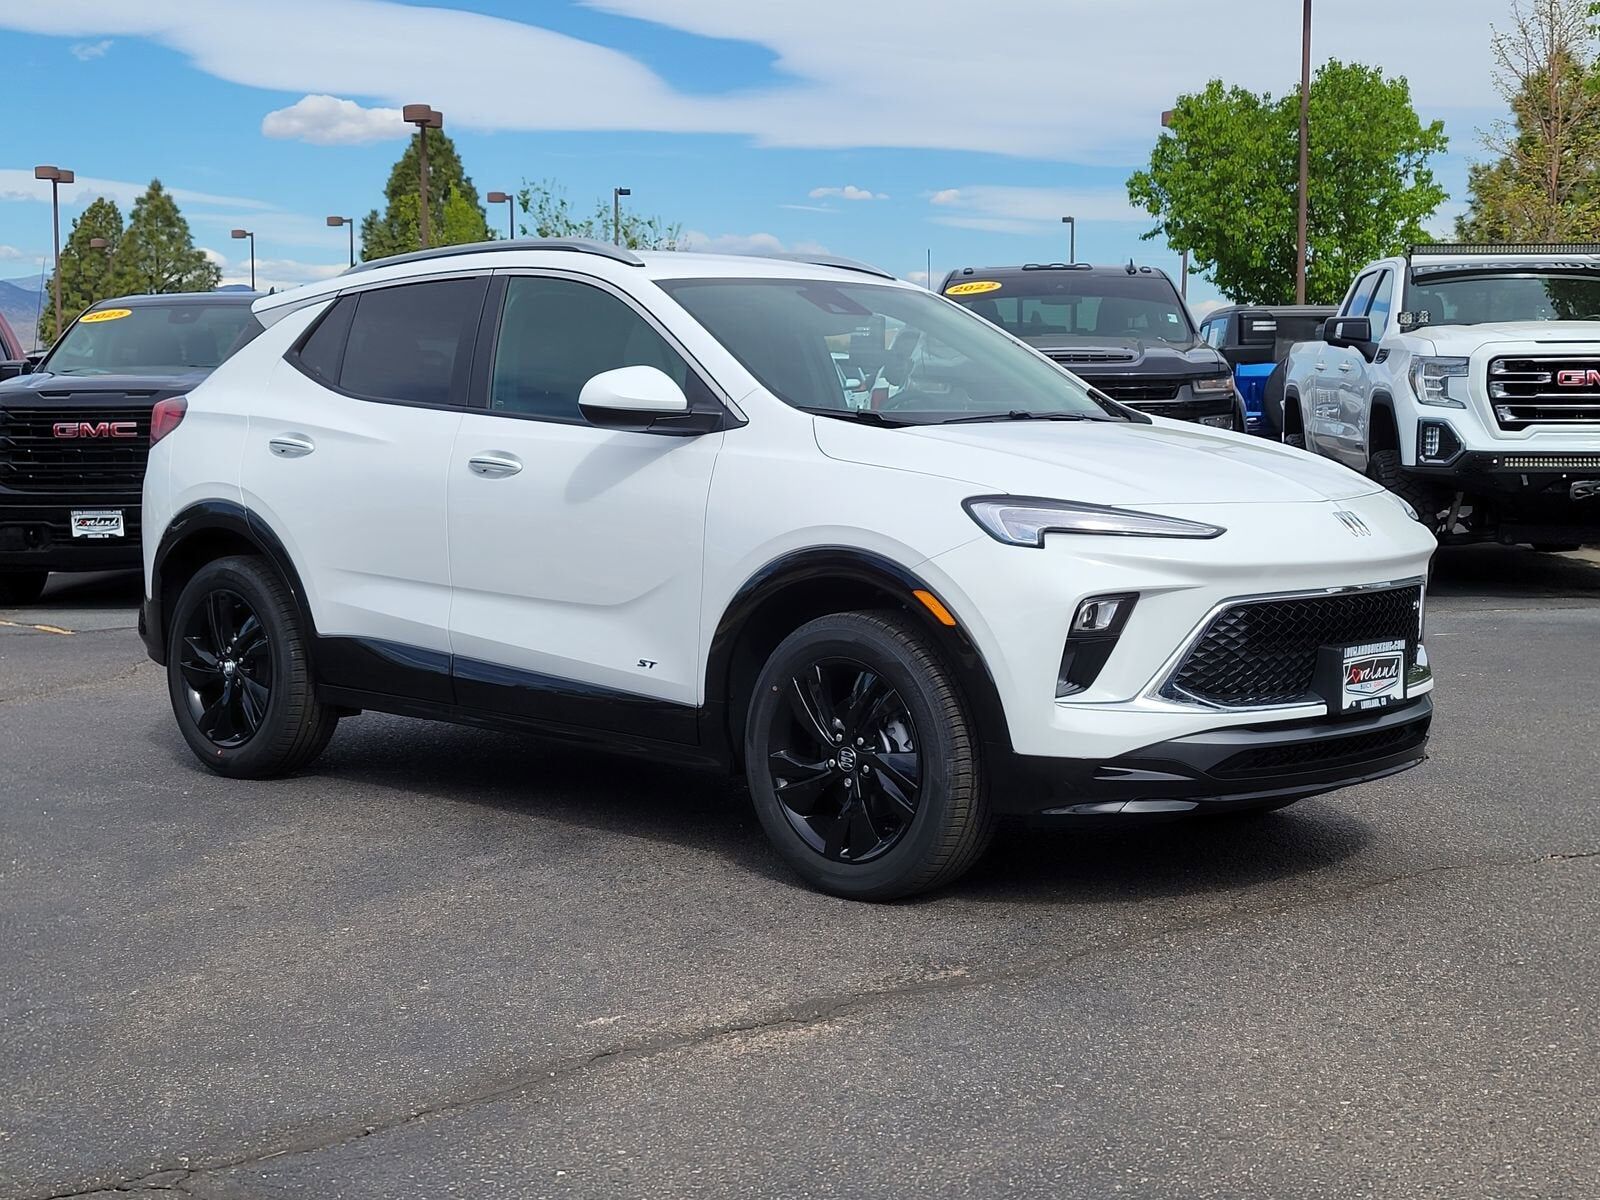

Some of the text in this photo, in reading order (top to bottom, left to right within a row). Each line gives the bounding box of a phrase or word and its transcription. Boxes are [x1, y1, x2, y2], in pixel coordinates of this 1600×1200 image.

[952, 282, 997, 293] 2022
[53, 421, 138, 438] GMC
[636, 659, 658, 669] ST
